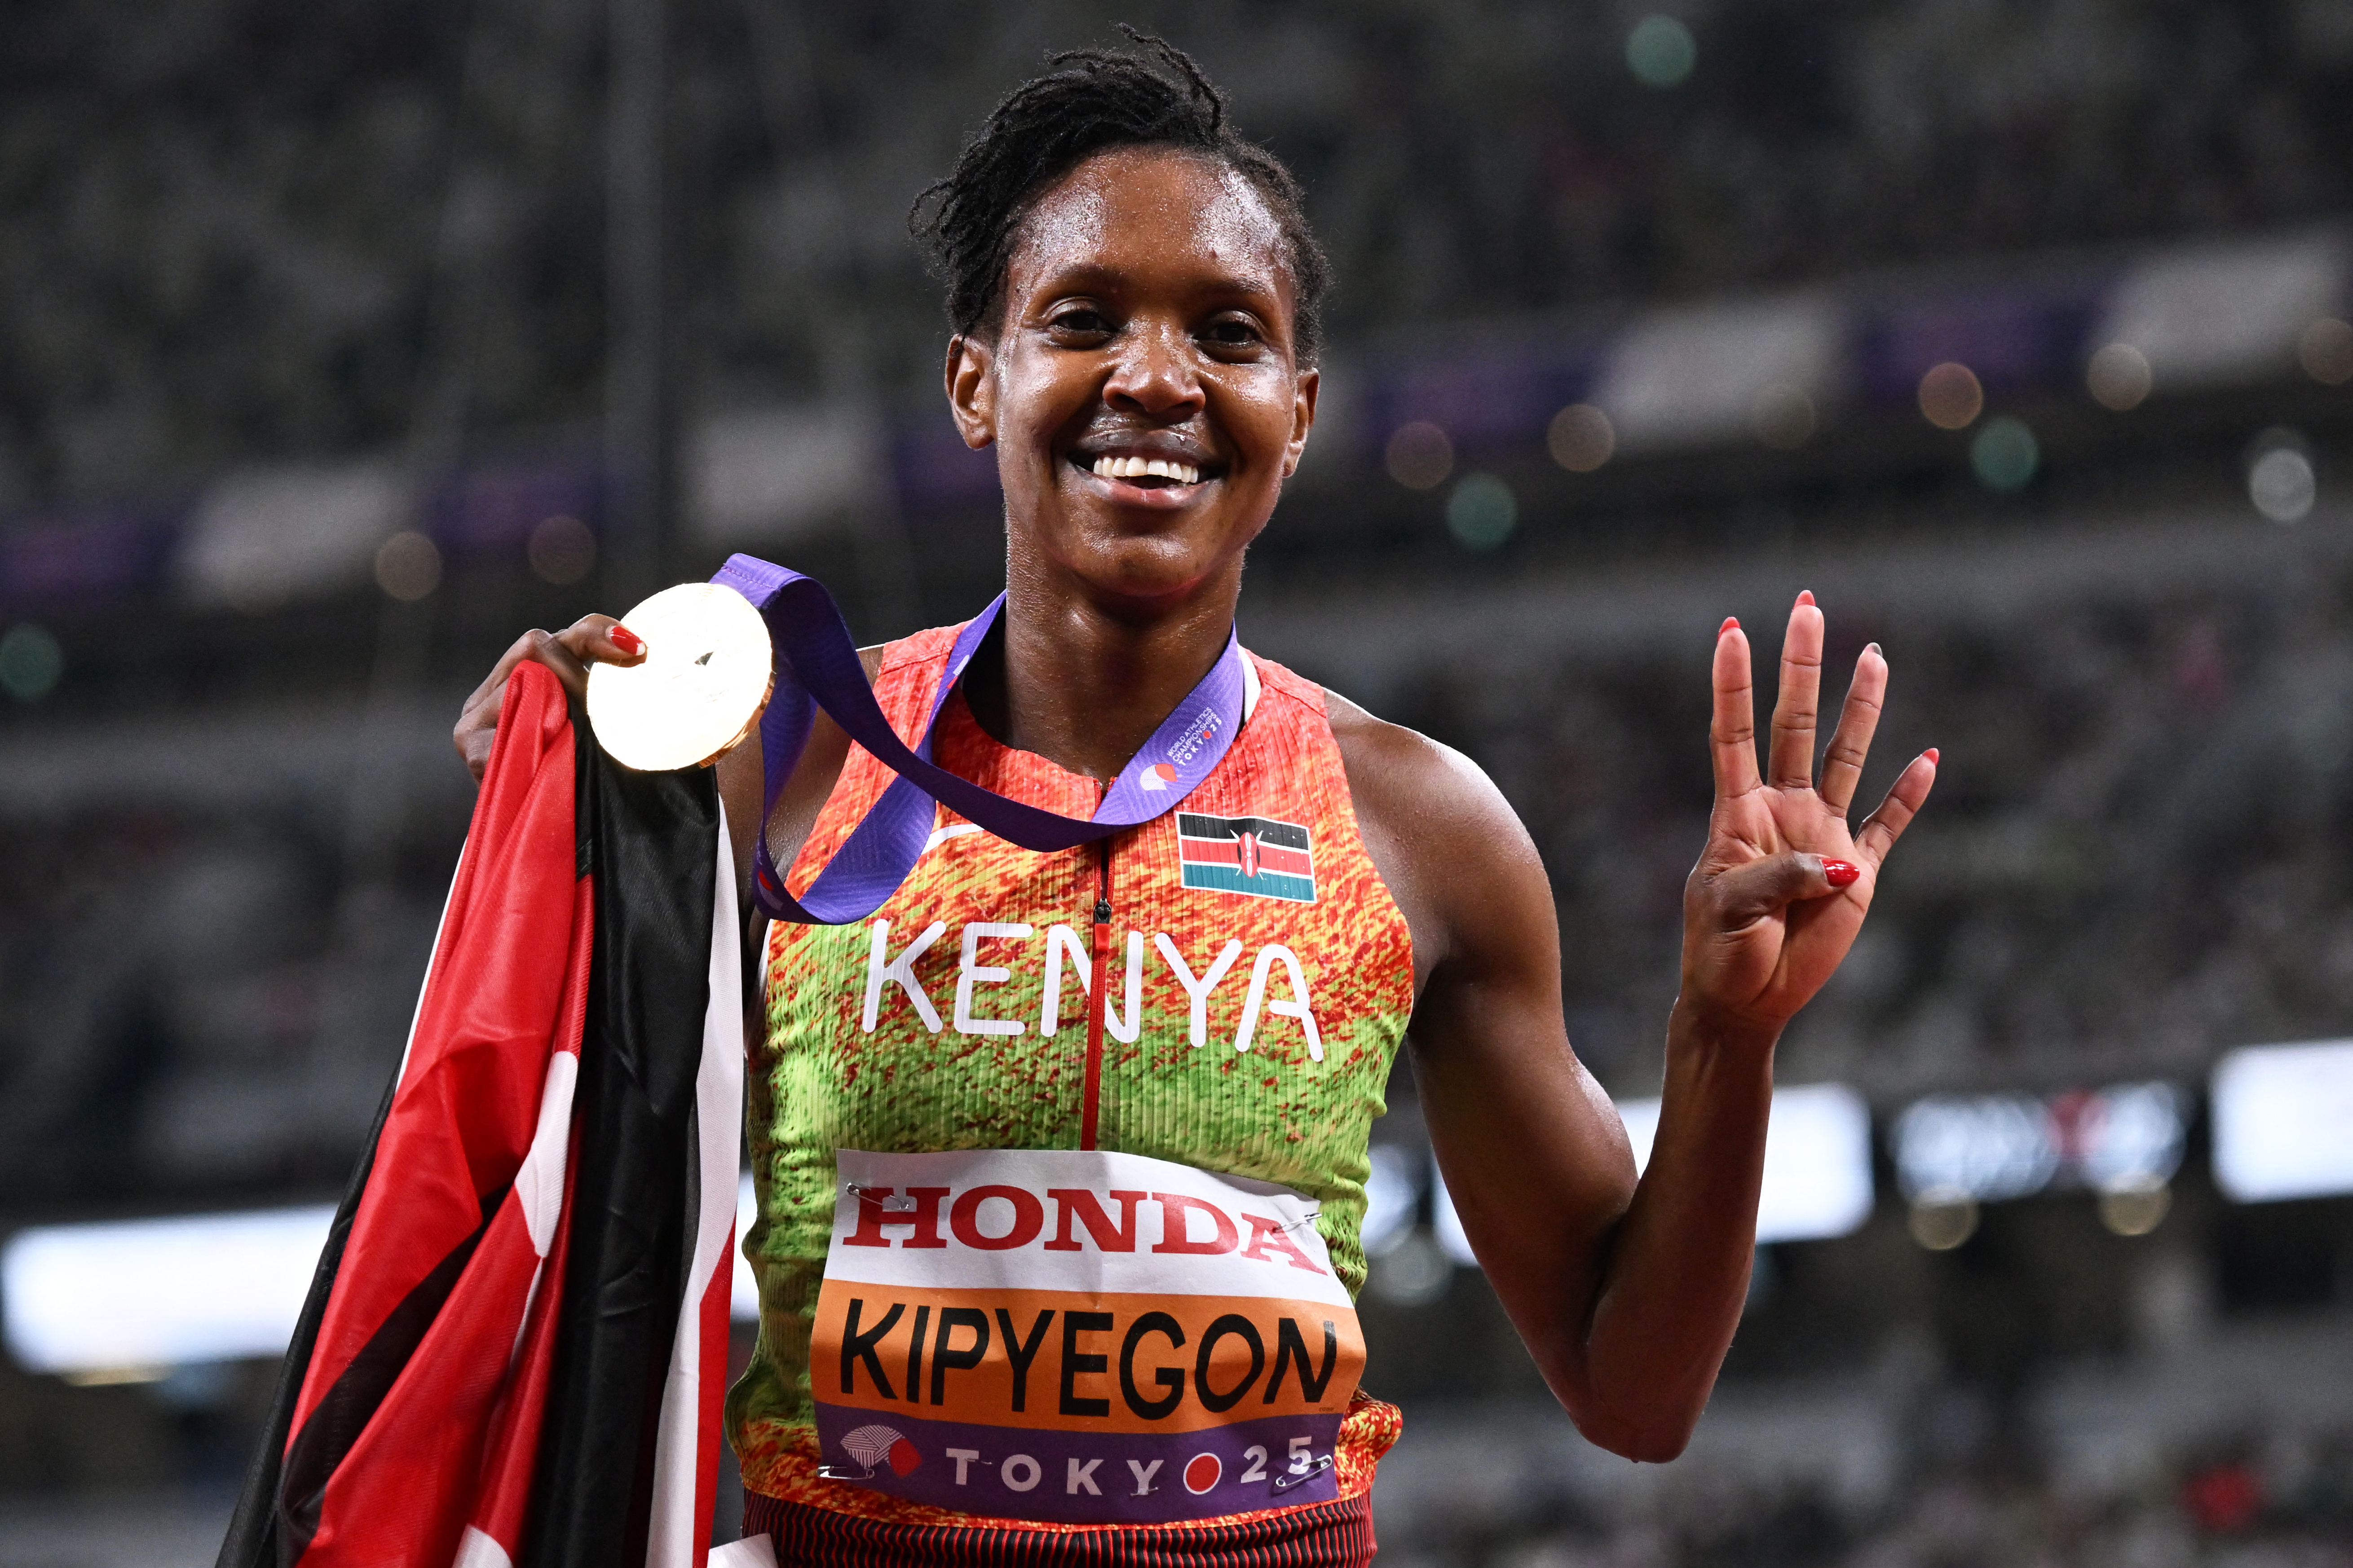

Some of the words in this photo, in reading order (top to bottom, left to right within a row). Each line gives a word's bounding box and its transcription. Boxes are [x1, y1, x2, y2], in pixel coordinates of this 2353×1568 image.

[1167, 736, 1186, 757] WORLD
[1184, 707, 1212, 737] ATHLETICS
[1173, 712, 1217, 762] CHAMPIONSHIPS
[862, 919, 1324, 1062] KENYA
[843, 1185, 1328, 1276] HONDA
[840, 1298, 1335, 1420] KIPYEGON
